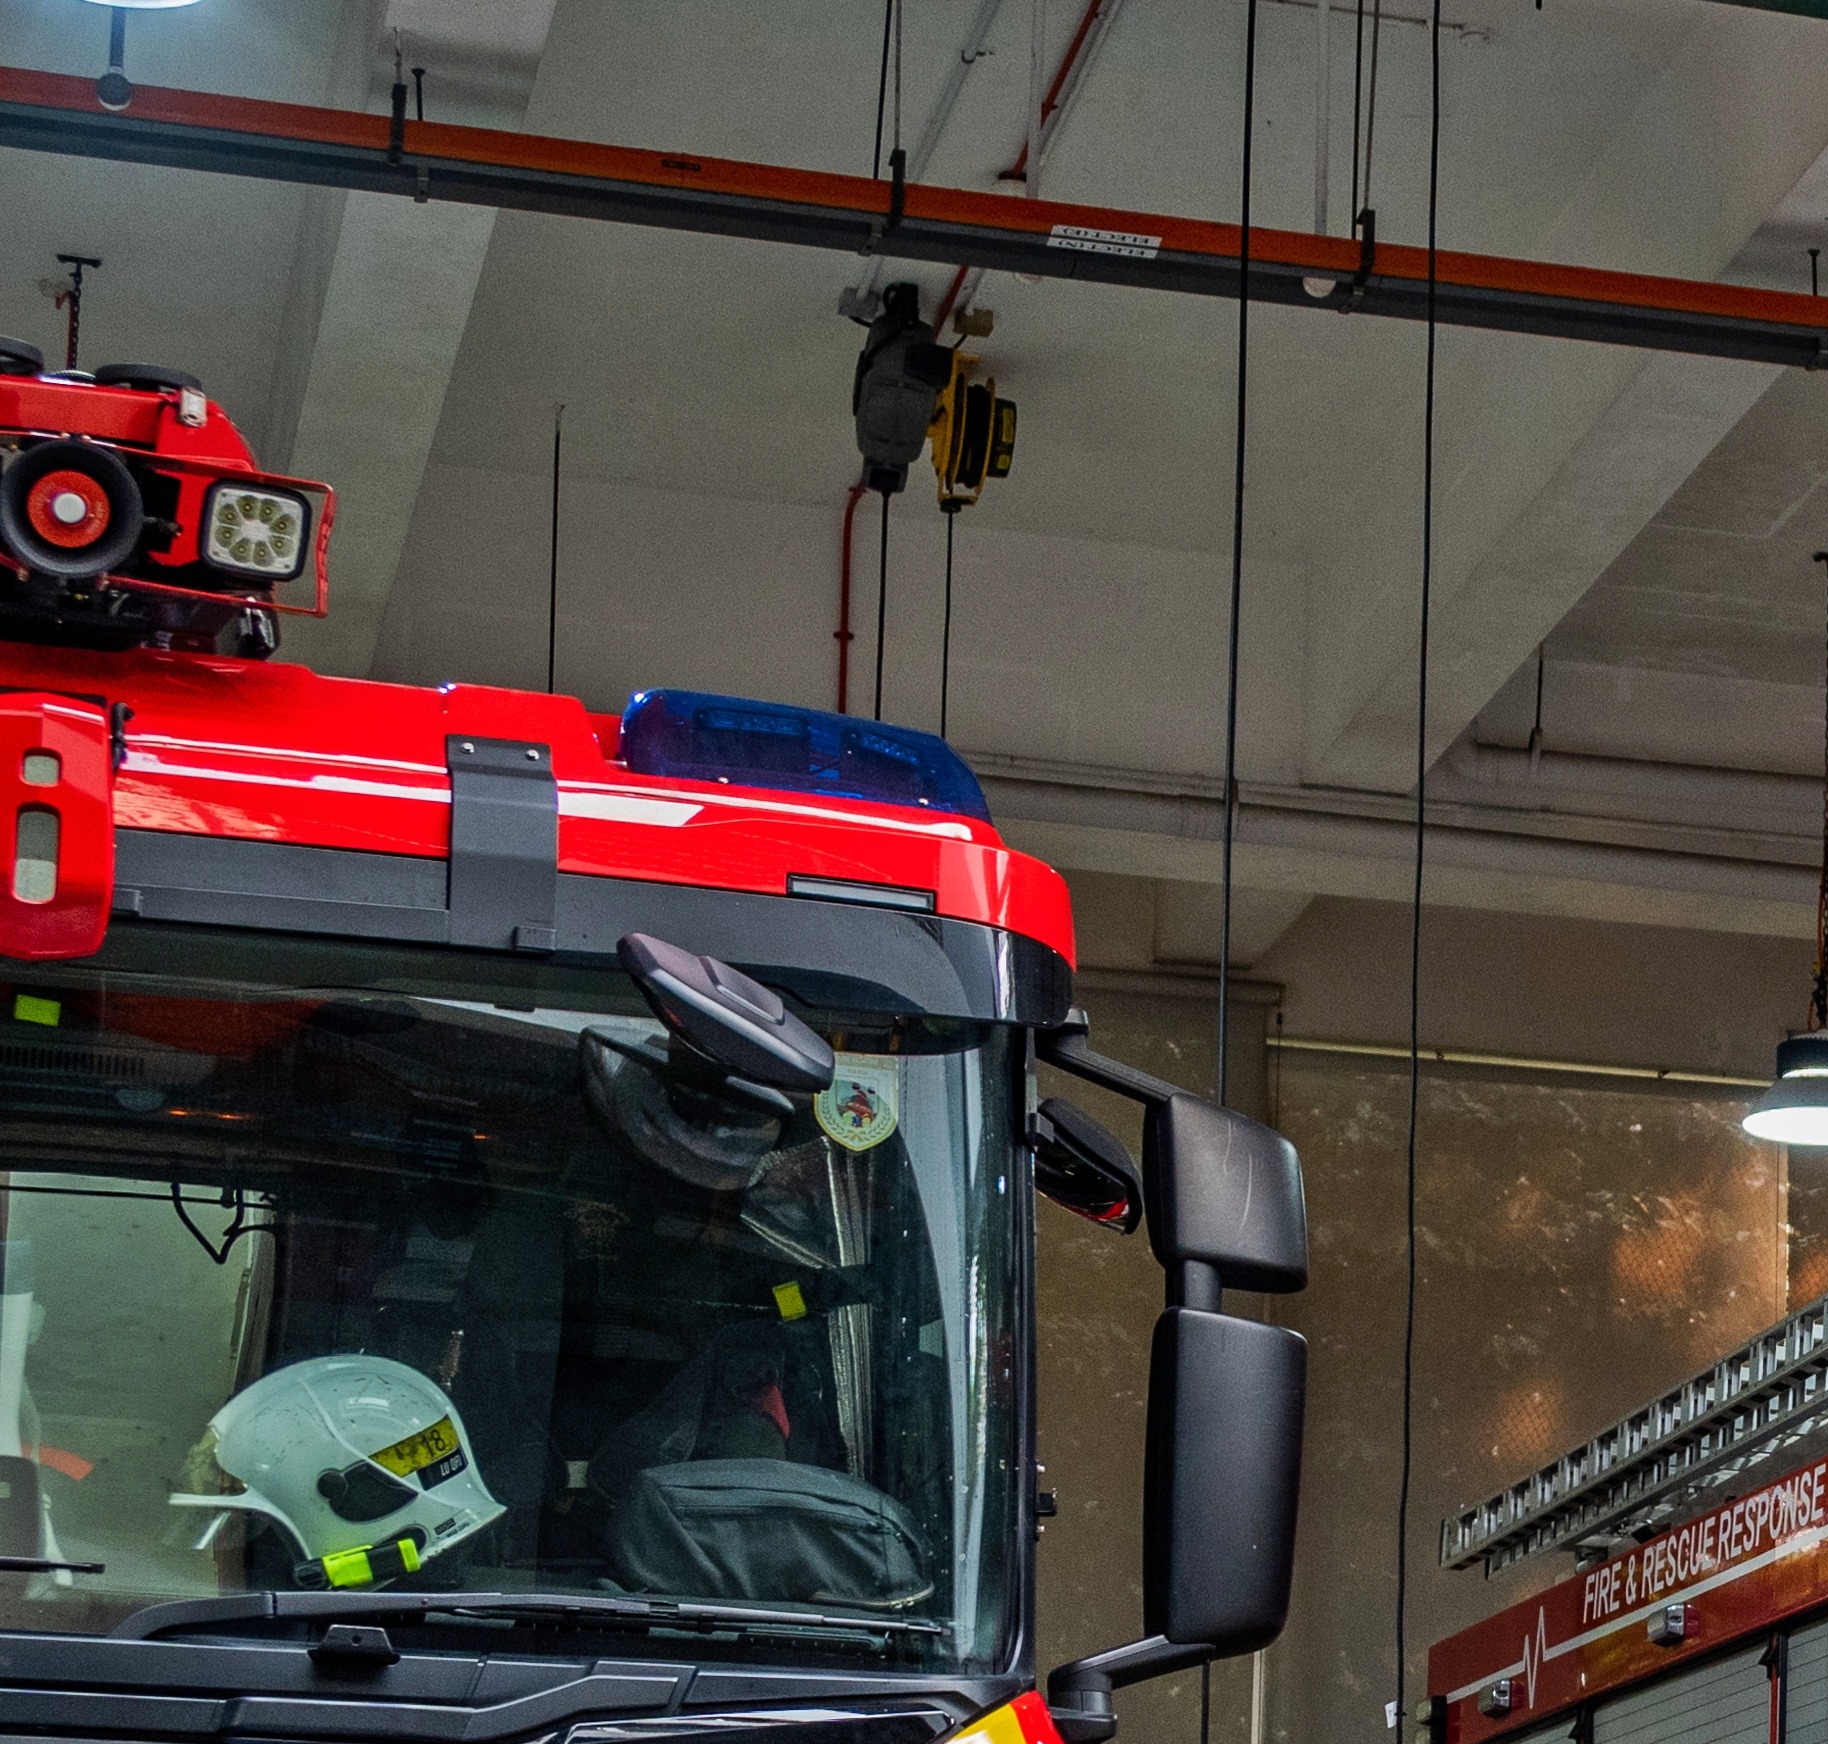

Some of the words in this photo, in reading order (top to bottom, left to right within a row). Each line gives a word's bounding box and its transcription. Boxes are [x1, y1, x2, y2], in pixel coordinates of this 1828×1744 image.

[1583, 1560, 1622, 1625] FIRE
[1625, 1554, 1637, 1604] &
[1641, 1516, 1716, 1599] RESCUE
[1717, 1463, 1827, 1564] RESPONSE
